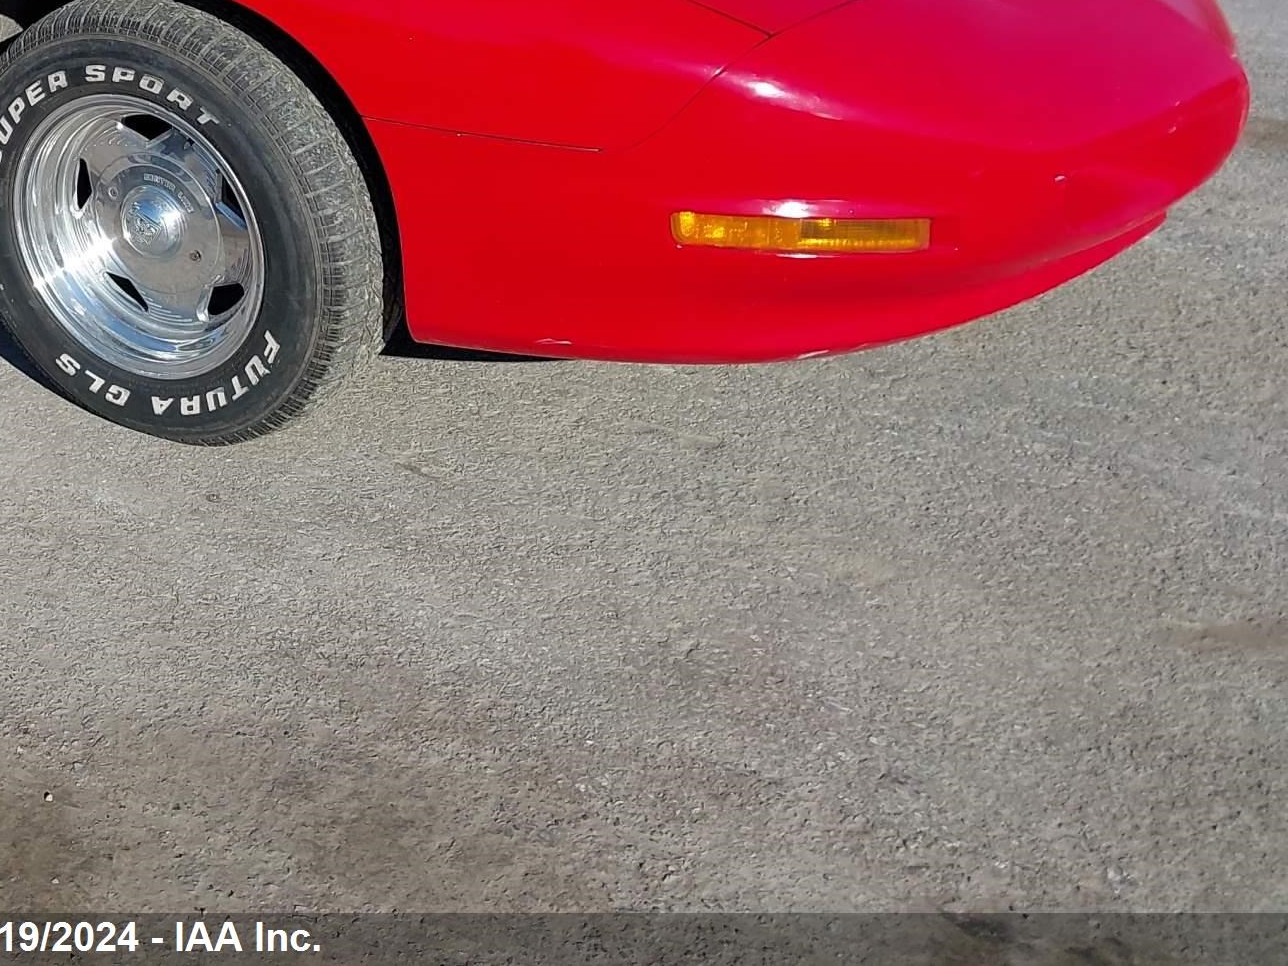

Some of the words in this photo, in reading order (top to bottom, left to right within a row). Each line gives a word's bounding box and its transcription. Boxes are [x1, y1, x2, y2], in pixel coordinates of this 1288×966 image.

[84, 64, 219, 126] SPORT
[55, 352, 132, 407] GLS
[150, 330, 281, 416] FUTURA
